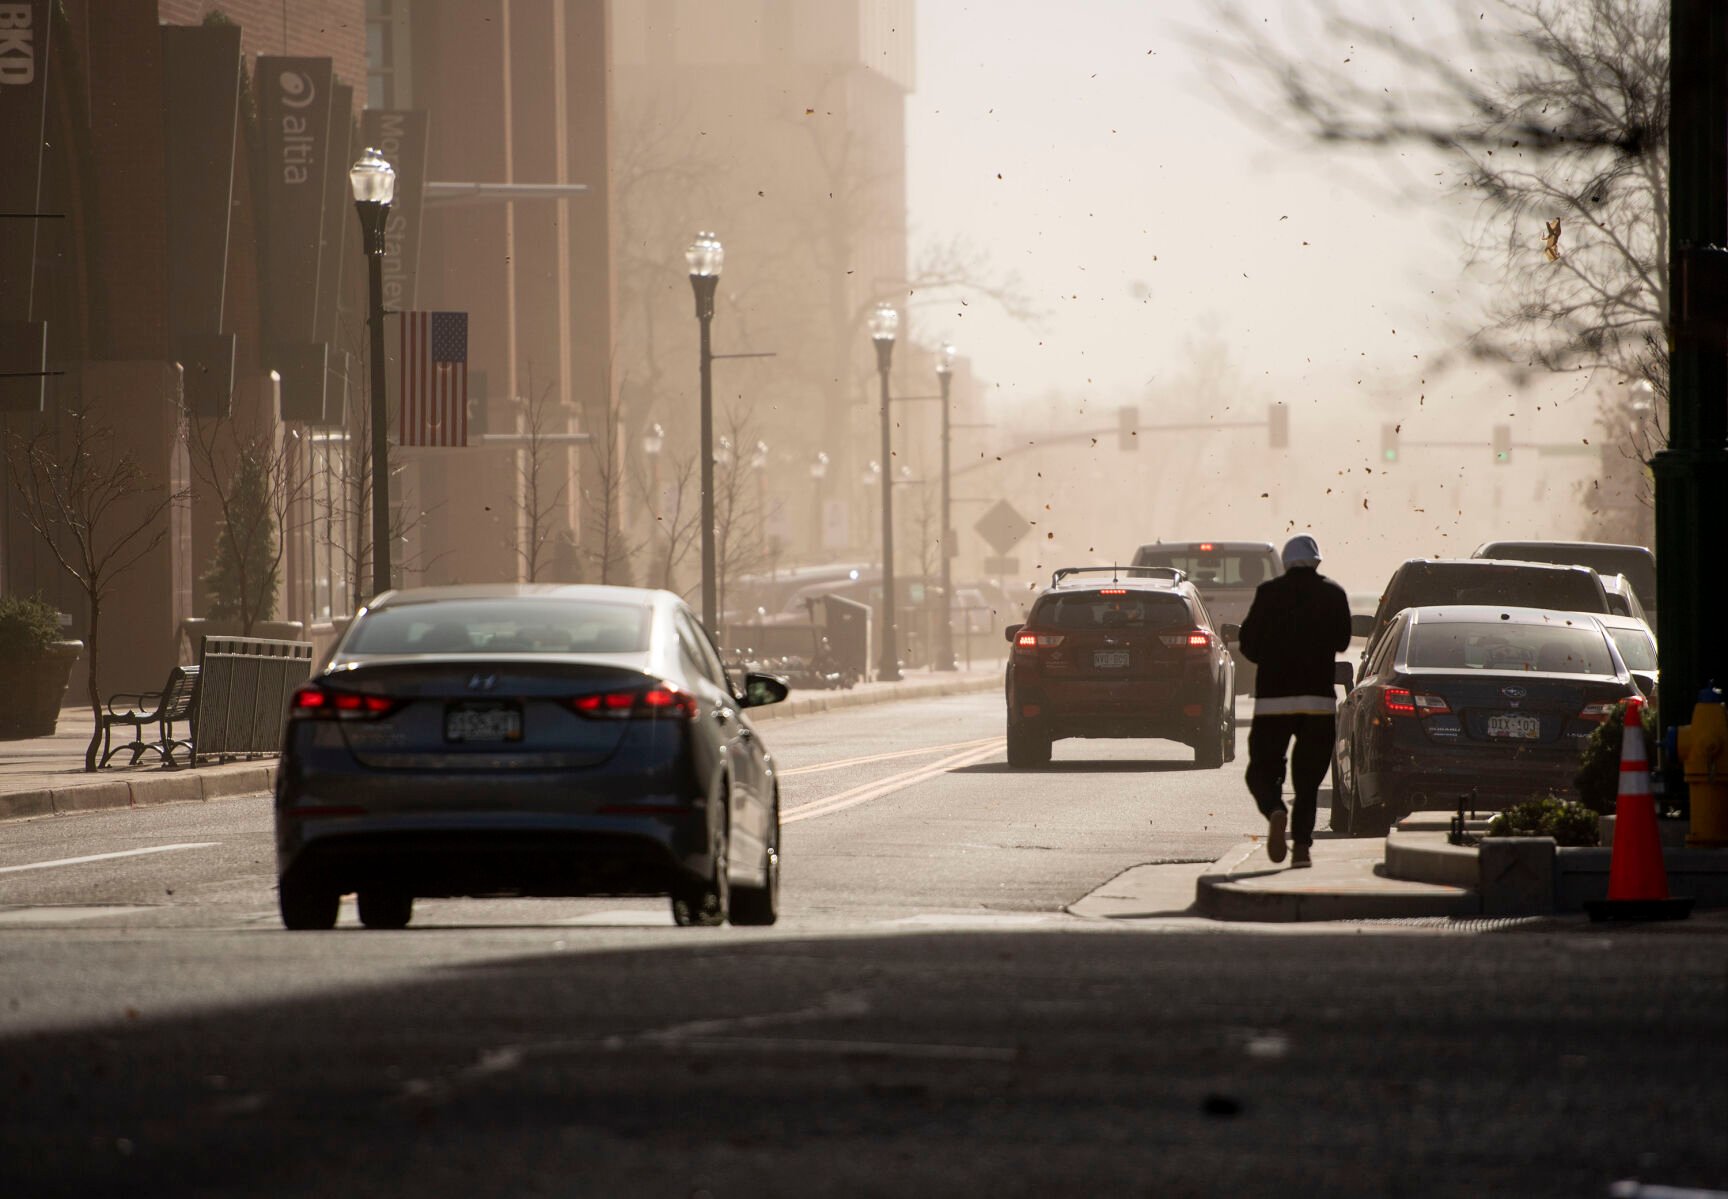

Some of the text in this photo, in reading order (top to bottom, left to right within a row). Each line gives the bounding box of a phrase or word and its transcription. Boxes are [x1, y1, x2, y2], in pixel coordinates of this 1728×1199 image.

[0, 4, 34, 85] BKD
[282, 115, 314, 184] altia
[381, 115, 407, 311] Mor Stanley
